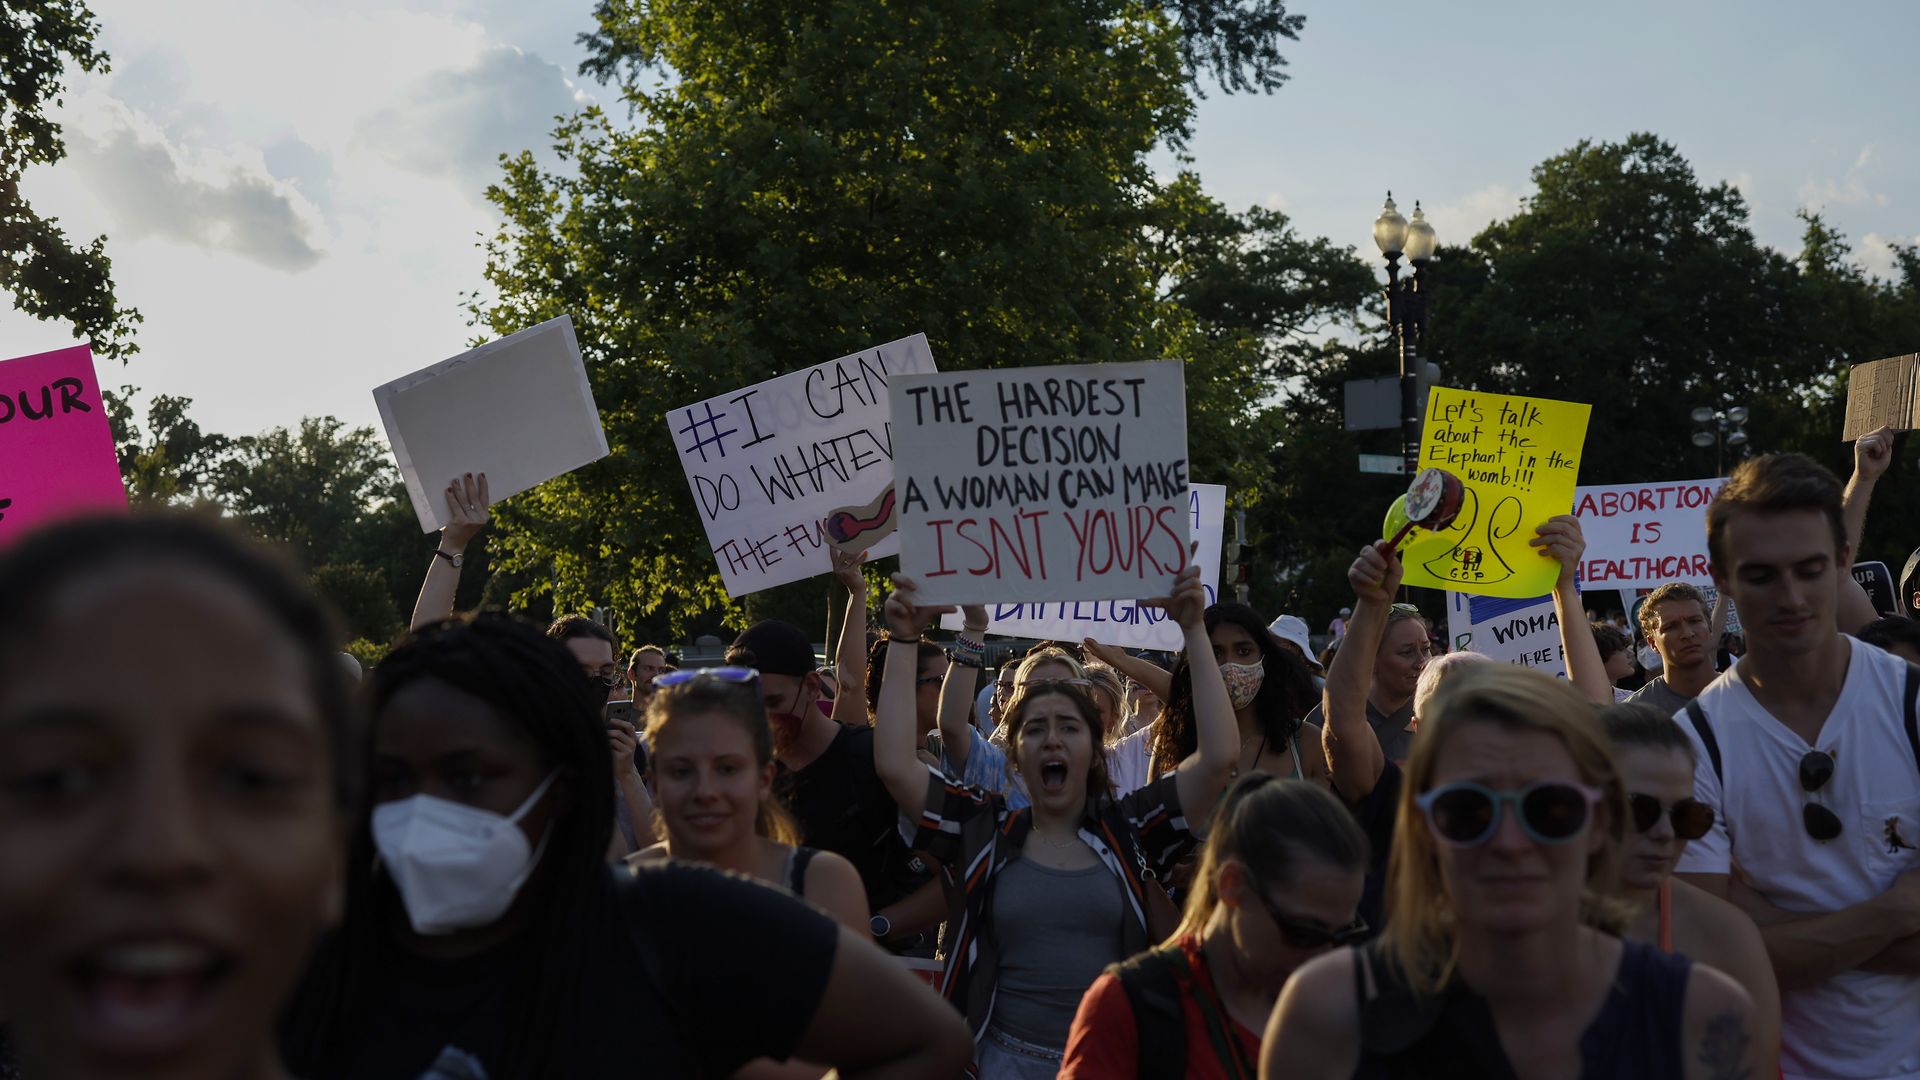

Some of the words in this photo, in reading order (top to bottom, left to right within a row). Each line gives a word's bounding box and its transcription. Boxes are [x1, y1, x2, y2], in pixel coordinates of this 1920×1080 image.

[806, 350, 888, 418] CAN
[906, 382, 974, 426] THE
[997, 378, 1145, 423] HARDEST
[1432, 393, 1484, 423] Let's
[1498, 401, 1543, 428] talk
[977, 423, 1121, 467] DECISION
[1434, 424, 1483, 444] about
[1498, 429, 1537, 448] the
[693, 473, 740, 520] DO
[750, 422, 893, 504] WHATEV
[1429, 445, 1506, 470] Elephant
[1519, 451, 1536, 467] in
[1545, 450, 1575, 470] the
[902, 476, 929, 514] A
[934, 469, 1050, 510] WOMAN
[1058, 467, 1114, 509] CAN
[1123, 459, 1189, 505] MAKE
[1468, 466, 1534, 492] womb!!!
[925, 507, 1049, 580] ISN'T
[1064, 506, 1185, 582] YOURS
[1630, 522, 1663, 544] IS
[714, 534, 782, 575] THE
[1578, 554, 1713, 582] EALTHCAR
[1492, 611, 1560, 645] WOMA
